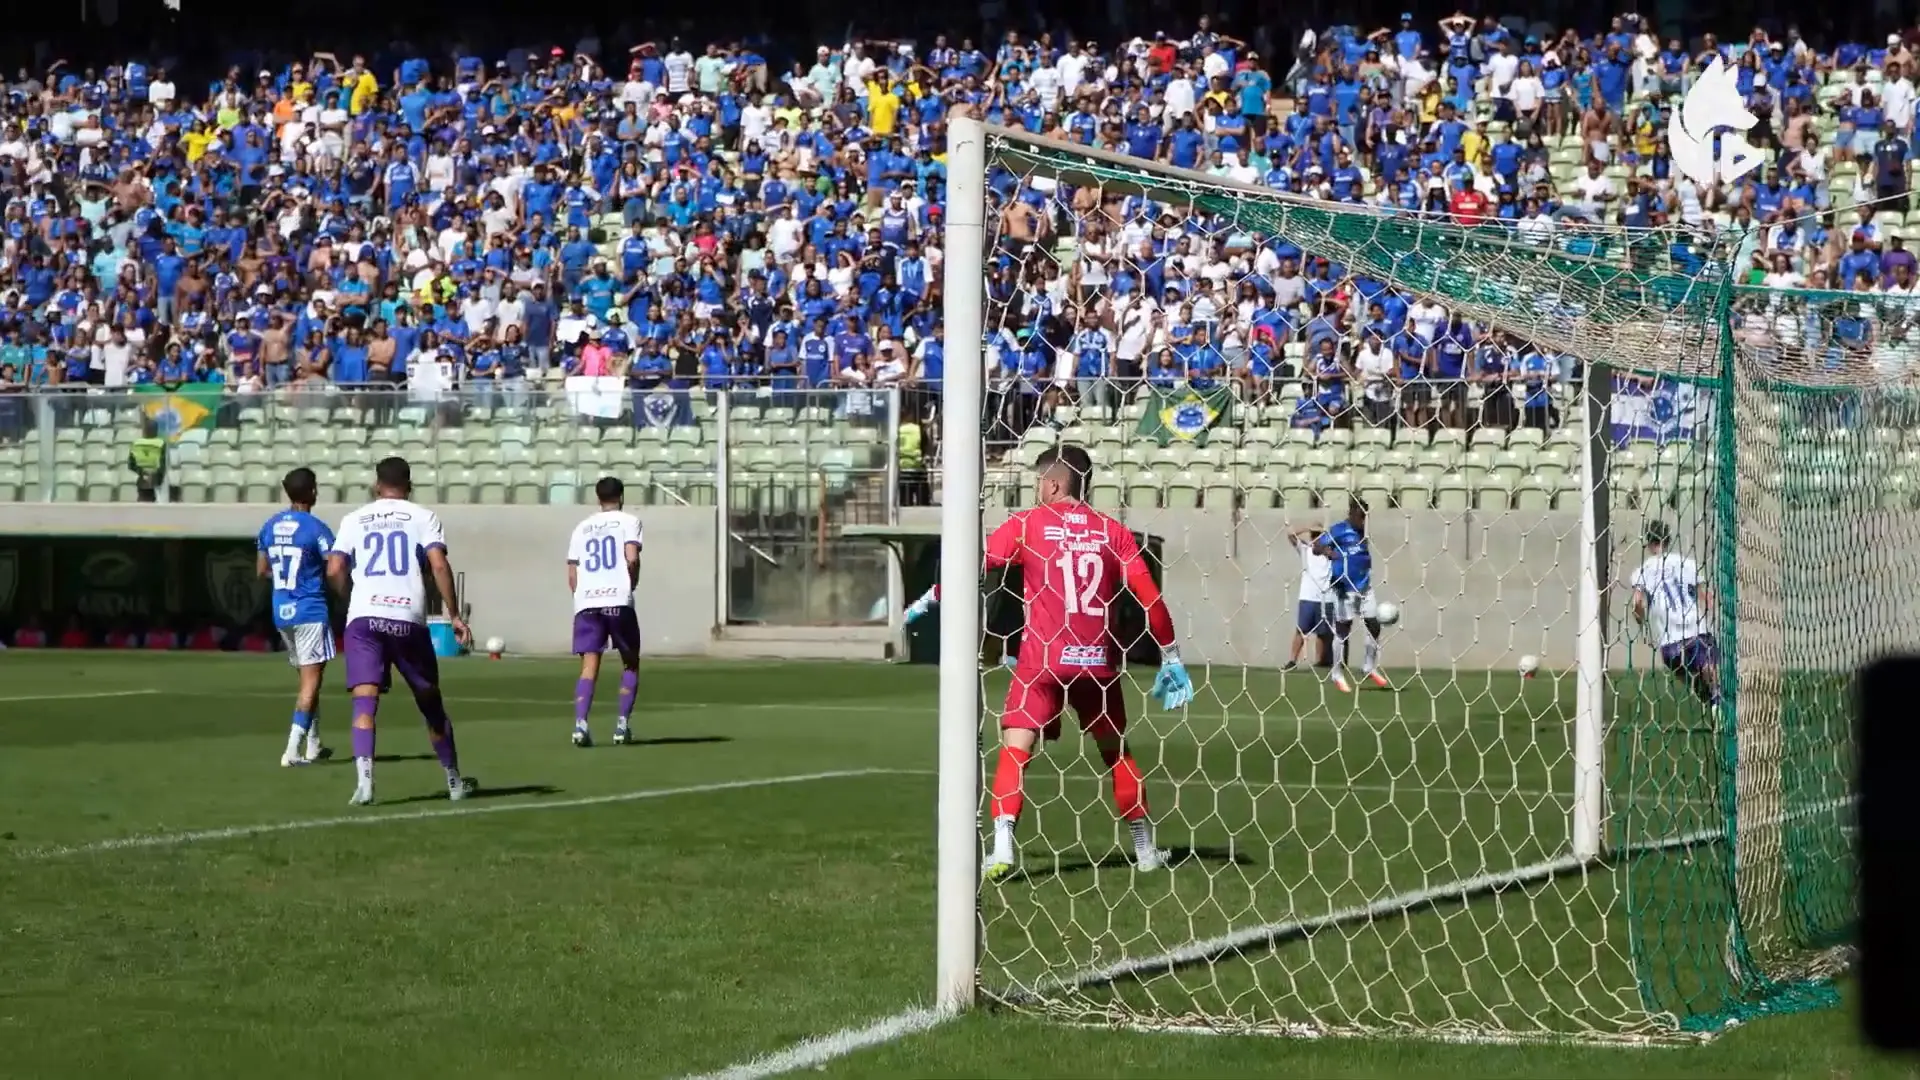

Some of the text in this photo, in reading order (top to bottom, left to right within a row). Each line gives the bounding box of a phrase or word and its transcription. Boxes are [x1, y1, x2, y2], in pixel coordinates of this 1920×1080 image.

[363, 530, 410, 577] 20
[585, 535, 617, 573] 30
[1044, 525, 1110, 544] BYD
[268, 545, 302, 591] 27
[1056, 551, 1104, 616] 12
